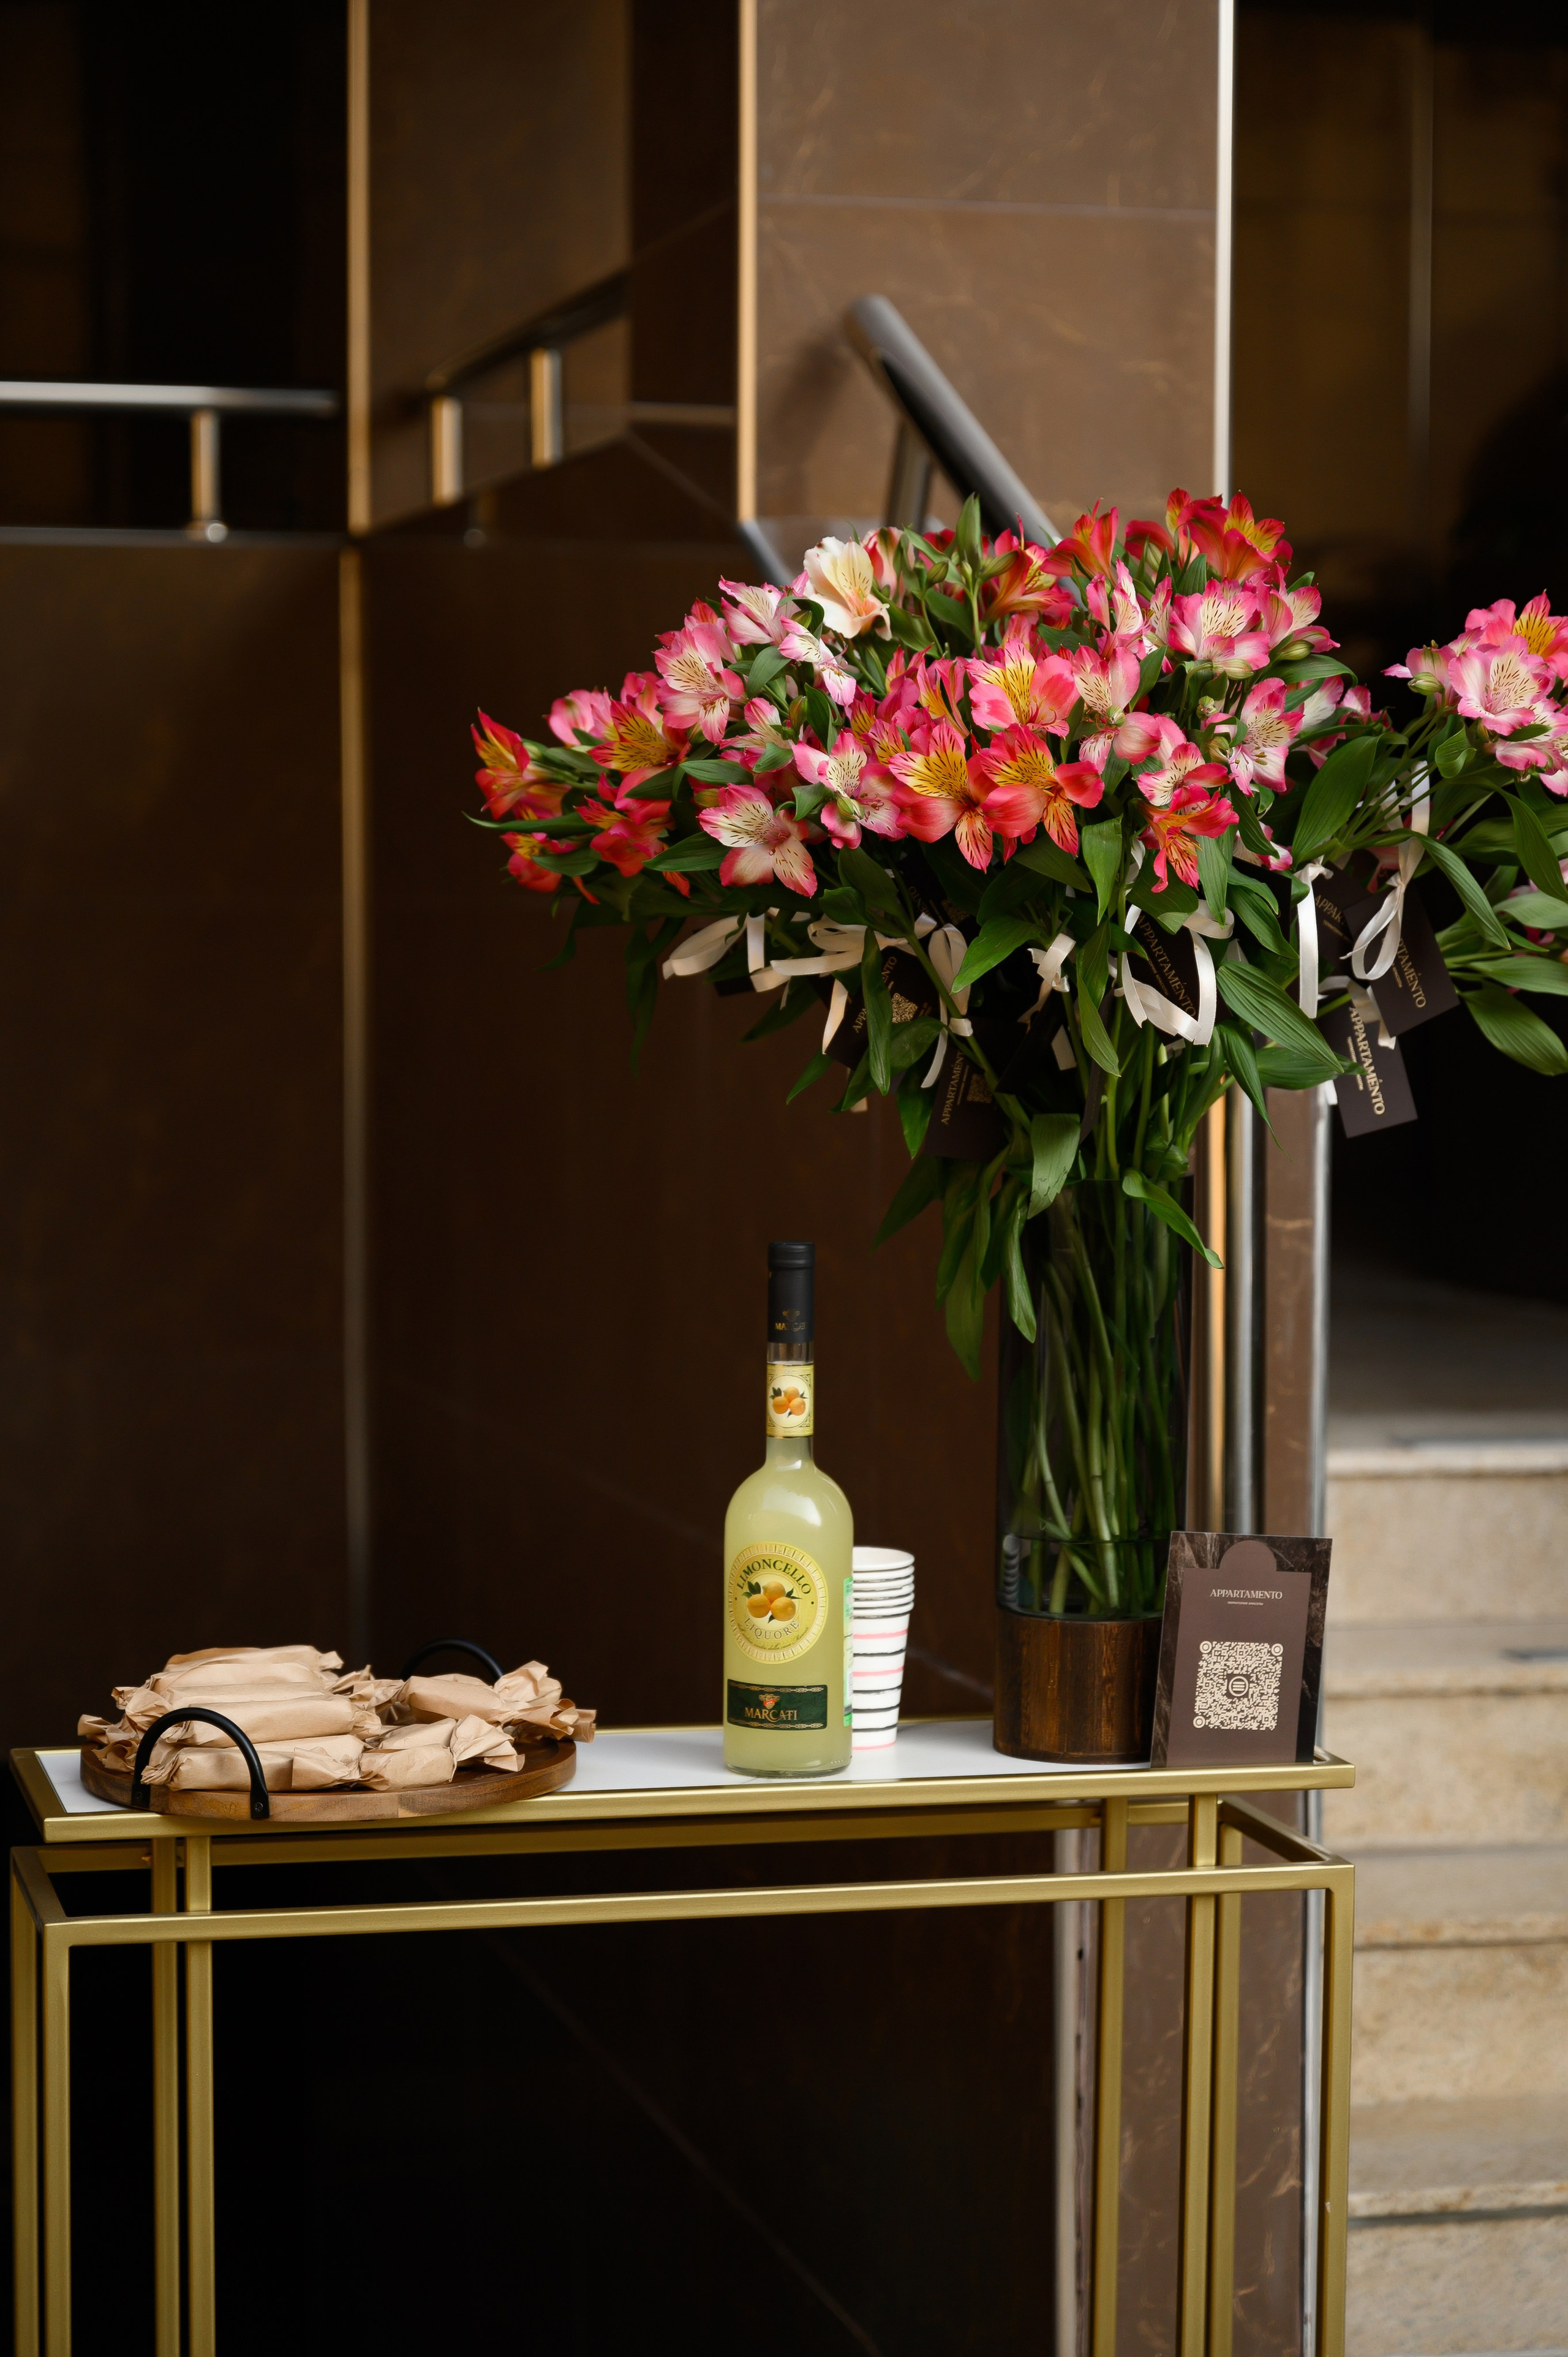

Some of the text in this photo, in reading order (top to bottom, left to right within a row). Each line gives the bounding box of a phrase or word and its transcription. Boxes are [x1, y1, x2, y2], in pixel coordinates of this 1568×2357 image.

[736, 1558, 812, 1594] LIMONCELLO
[1210, 1589, 1283, 1599] APPARTAMENTO
[744, 1618, 799, 1640] LIQUORE
[744, 1707, 797, 1722] MARCATI
